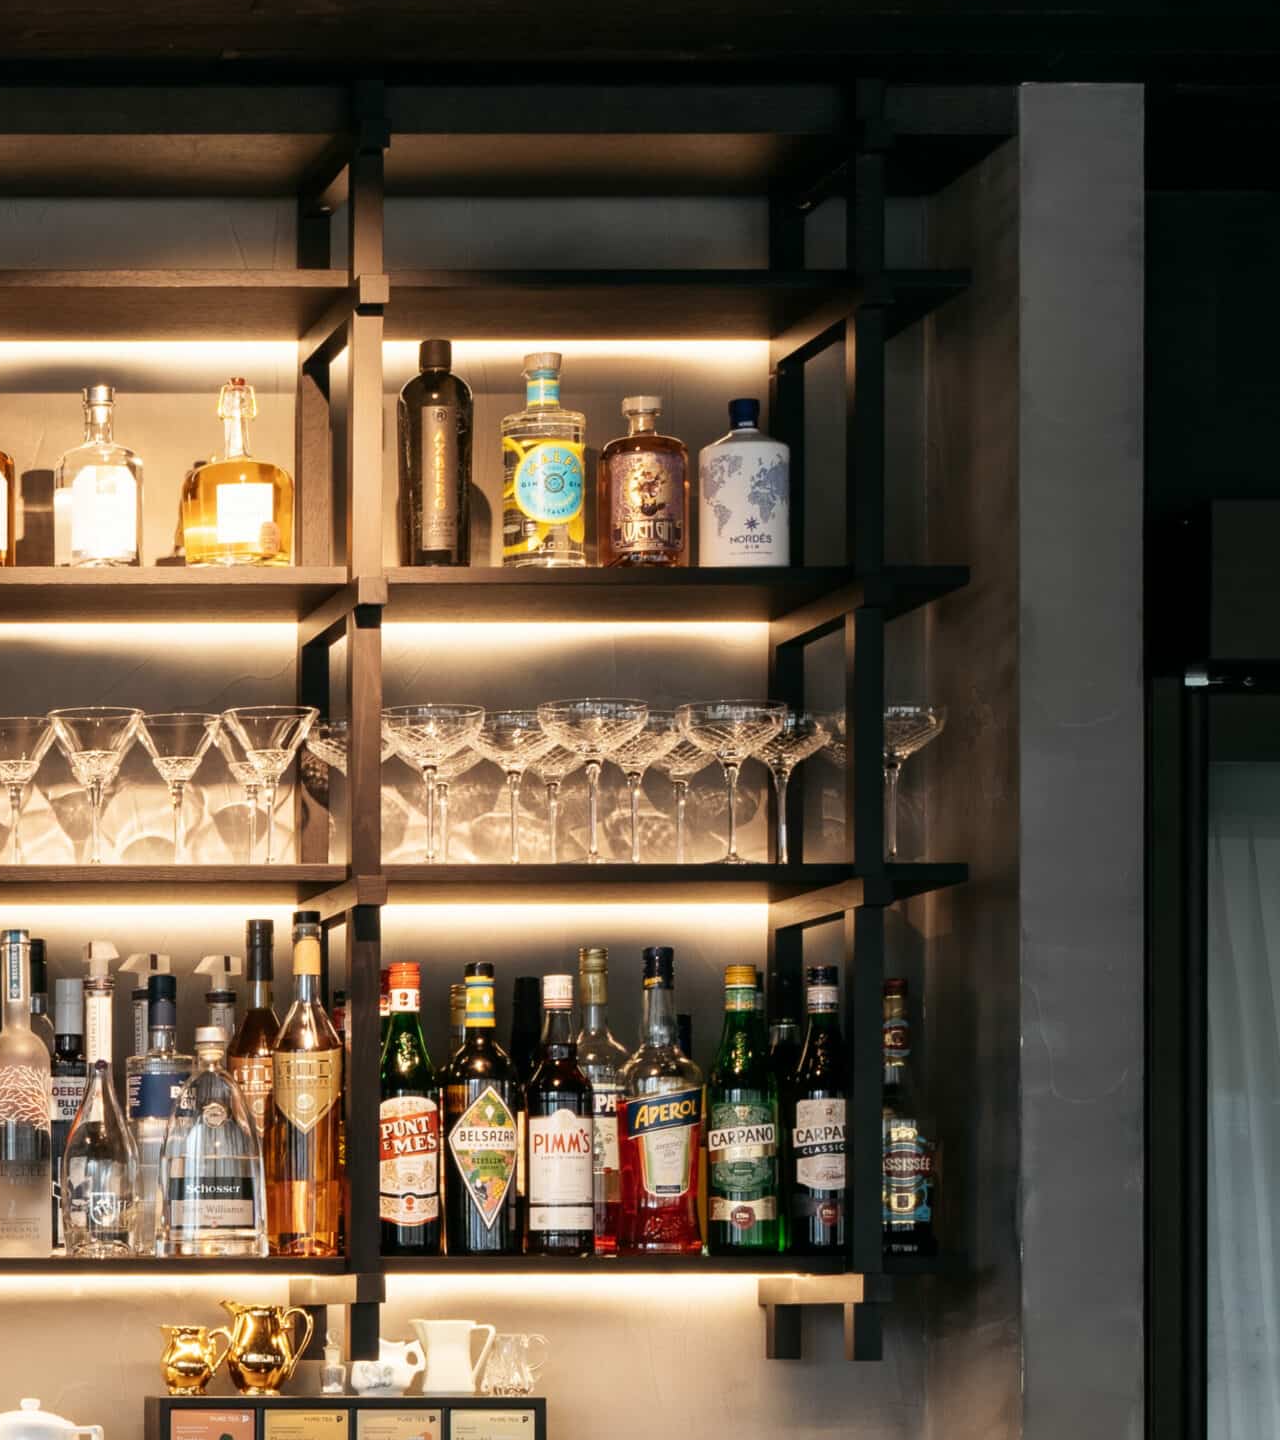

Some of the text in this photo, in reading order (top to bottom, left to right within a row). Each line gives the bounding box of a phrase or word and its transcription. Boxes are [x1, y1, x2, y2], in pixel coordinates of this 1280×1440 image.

[729, 533, 773, 545] NORDÉS
[634, 1099, 698, 1129] APEROL
[380, 1116, 430, 1140] PUNT
[459, 1130, 515, 1142] BELSAZAR
[710, 1126, 774, 1147] CARPANO
[393, 1132, 438, 1155] MES
[532, 1128, 591, 1154] PIMM'S
[185, 1183, 241, 1194] Schosser
